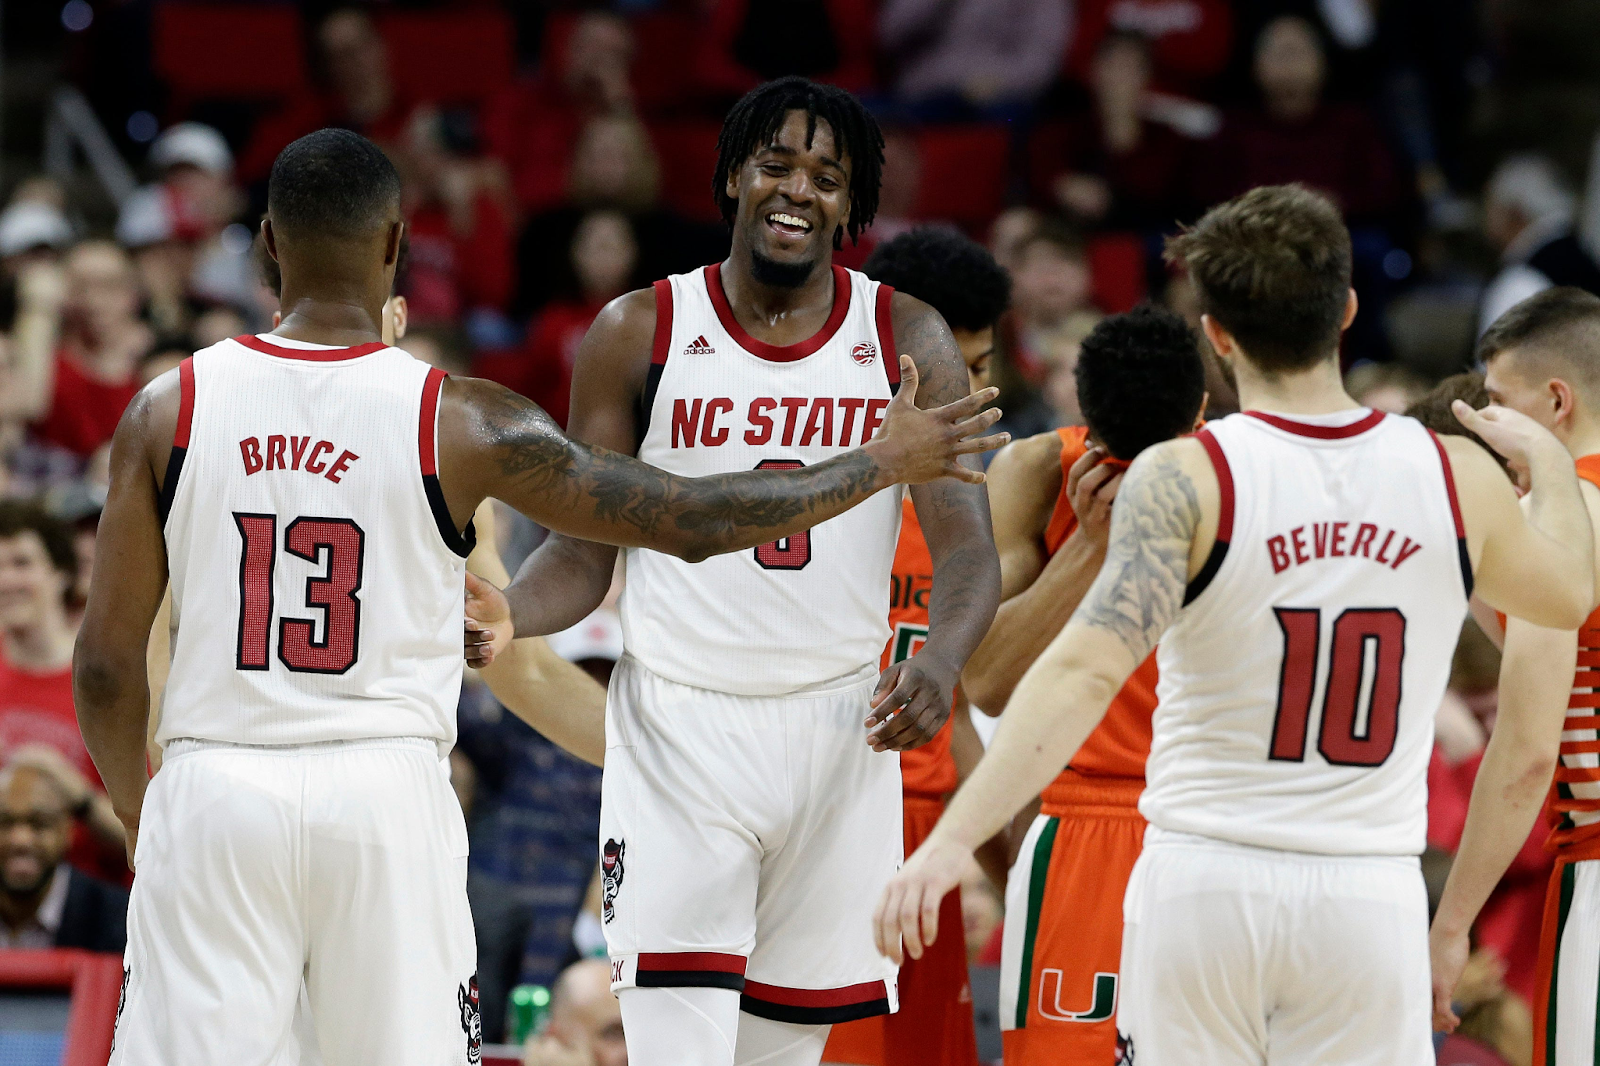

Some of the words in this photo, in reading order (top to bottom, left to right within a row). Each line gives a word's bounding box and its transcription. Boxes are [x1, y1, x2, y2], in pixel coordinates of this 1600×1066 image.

[683, 347, 716, 355] adidas
[853, 347, 876, 356] ACC
[671, 397, 734, 449] NC
[743, 397, 892, 447] STATE
[239, 434, 360, 484] BRYCE
[1266, 521, 1423, 575] BEVERLY
[231, 511, 365, 675] 13
[1268, 606, 1407, 768] 10
[1038, 968, 1119, 1023] U
